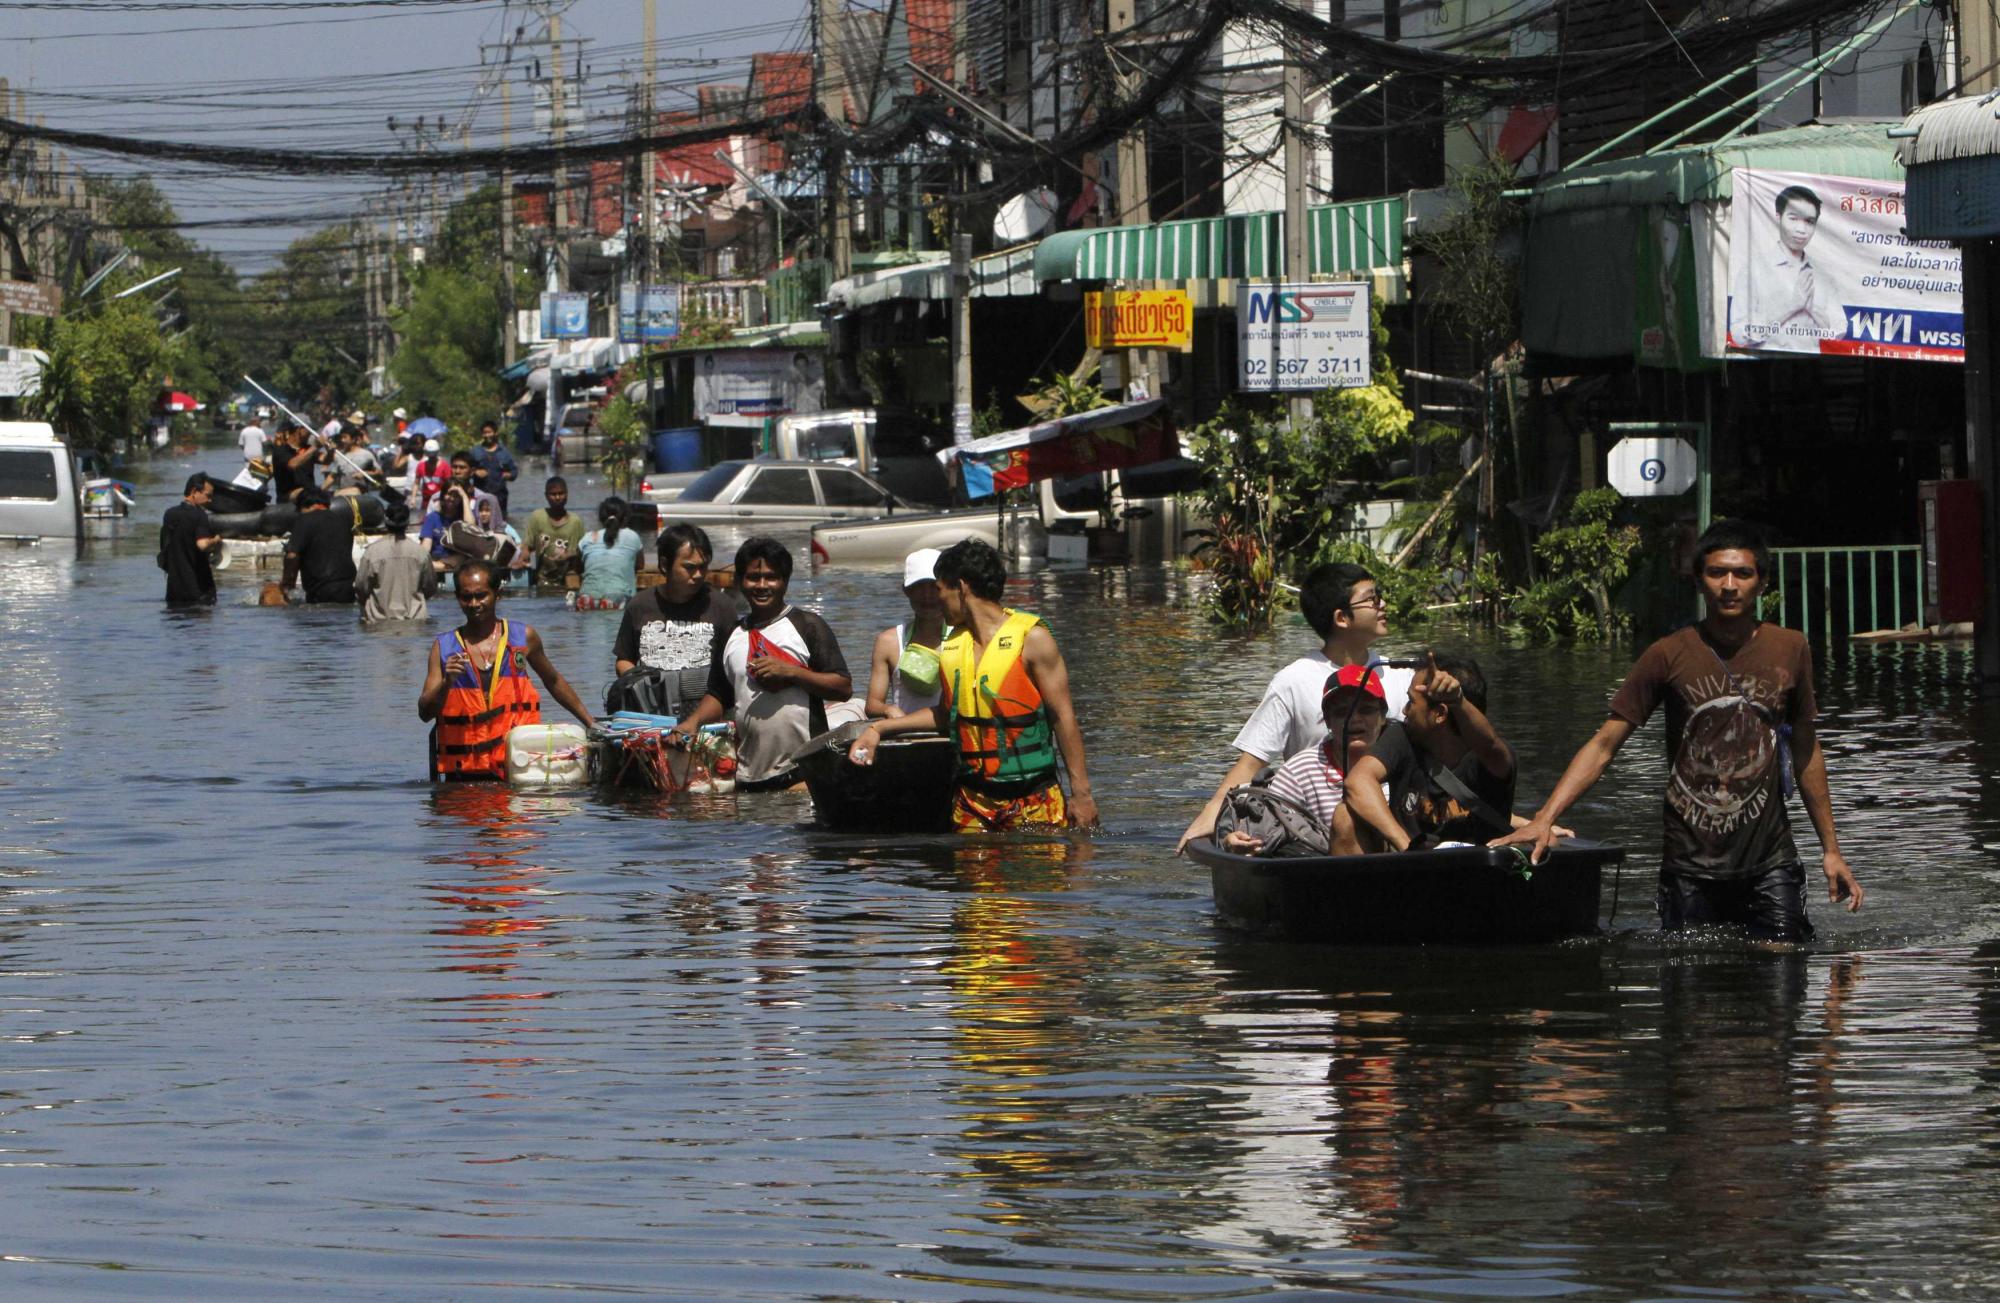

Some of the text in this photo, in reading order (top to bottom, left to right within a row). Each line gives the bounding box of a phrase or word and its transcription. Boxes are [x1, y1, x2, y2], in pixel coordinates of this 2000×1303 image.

[1840, 189, 1906, 216] สวัสดี
[1248, 292, 1314, 323] MSS
[1314, 297, 1354, 306] CABLE TV
[1850, 312, 1965, 347] พท พรร
[1244, 357, 1361, 374] 02 567 3711
[1244, 376, 1364, 386] www.msscabletv.com
